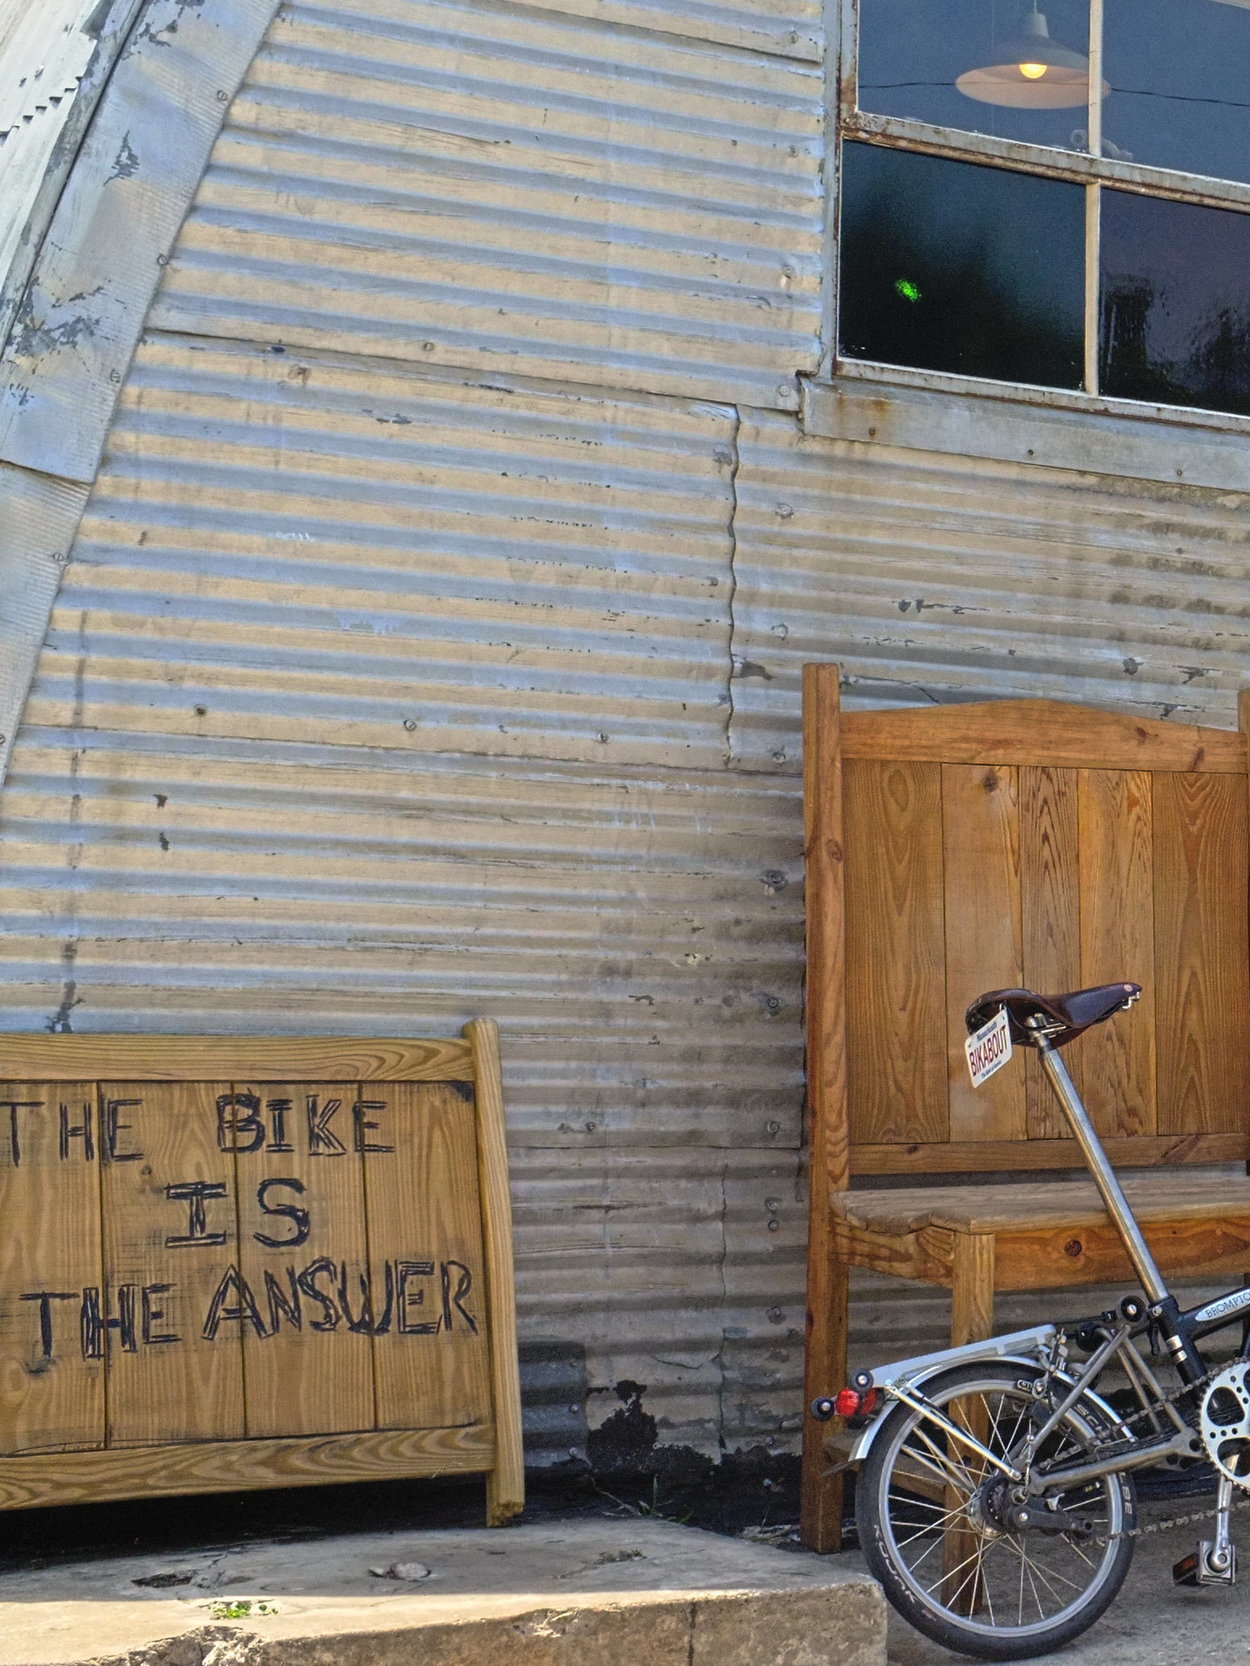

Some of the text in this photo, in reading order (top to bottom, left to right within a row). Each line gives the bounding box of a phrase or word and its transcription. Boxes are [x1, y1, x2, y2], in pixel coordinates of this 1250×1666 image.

[969, 1024, 1008, 1077] BIKABOUT
[0, 1088, 396, 1168] THE BIKE
[165, 1177, 311, 1248] IS
[19, 1256, 480, 1361] THE ANSWER
